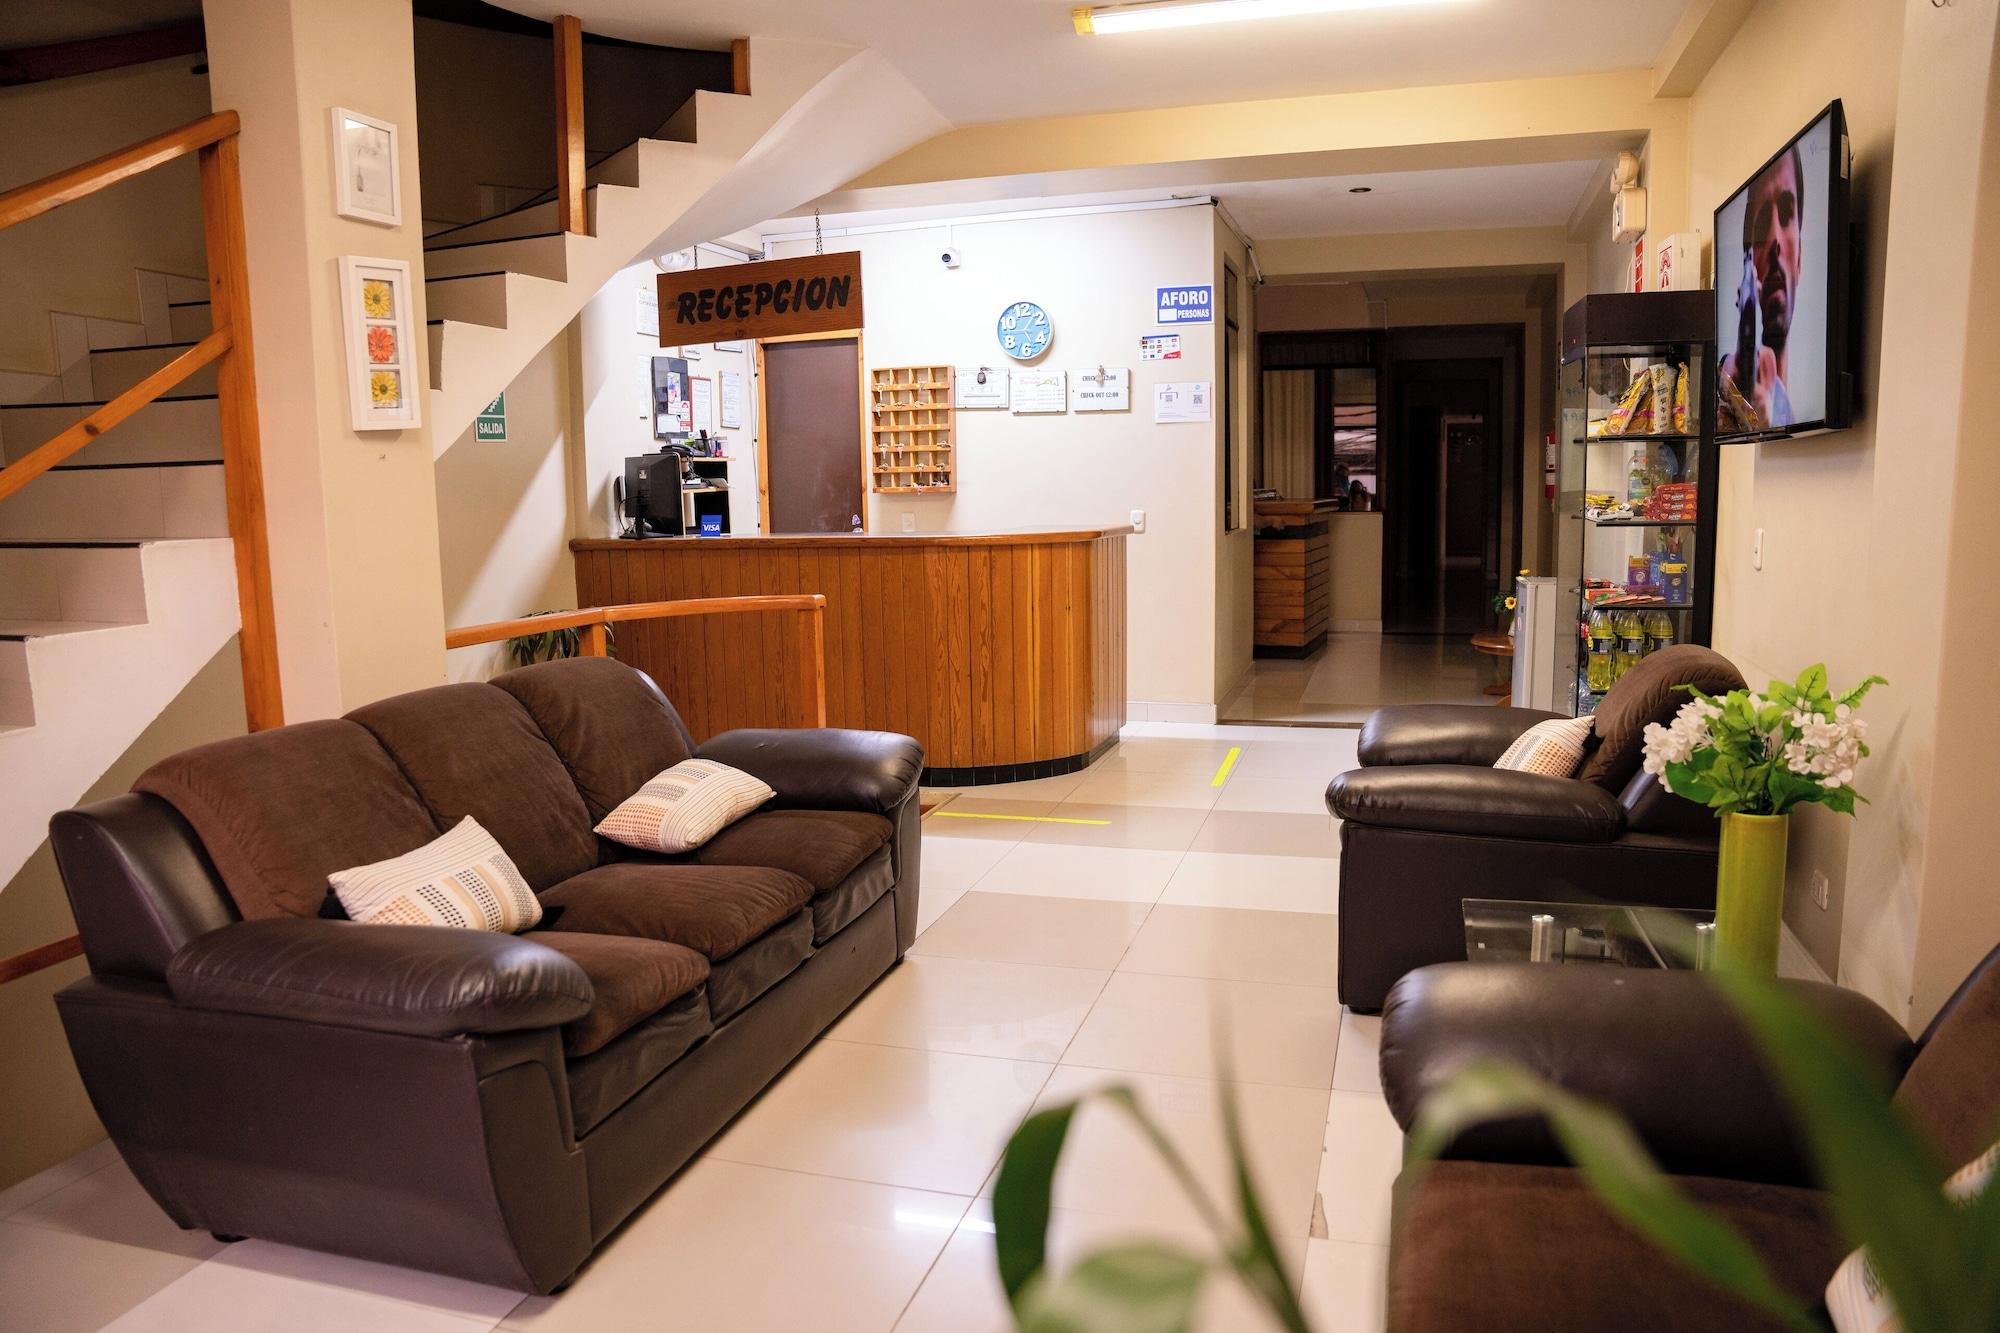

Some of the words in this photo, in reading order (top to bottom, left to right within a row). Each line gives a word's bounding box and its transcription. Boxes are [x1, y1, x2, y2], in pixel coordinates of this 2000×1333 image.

[676, 275, 851, 326] RECEPCION
[1161, 290, 1208, 306] AFORO
[1013, 303, 1032, 318] 12
[1178, 309, 1210, 319] PERSONAS
[1000, 315, 1016, 330] 10
[1033, 311, 1046, 326] 2
[1004, 335, 1016, 349] 8
[1034, 331, 1047, 345] 4
[1021, 342, 1032, 357] 6
[479, 422, 504, 434] SALIDA
